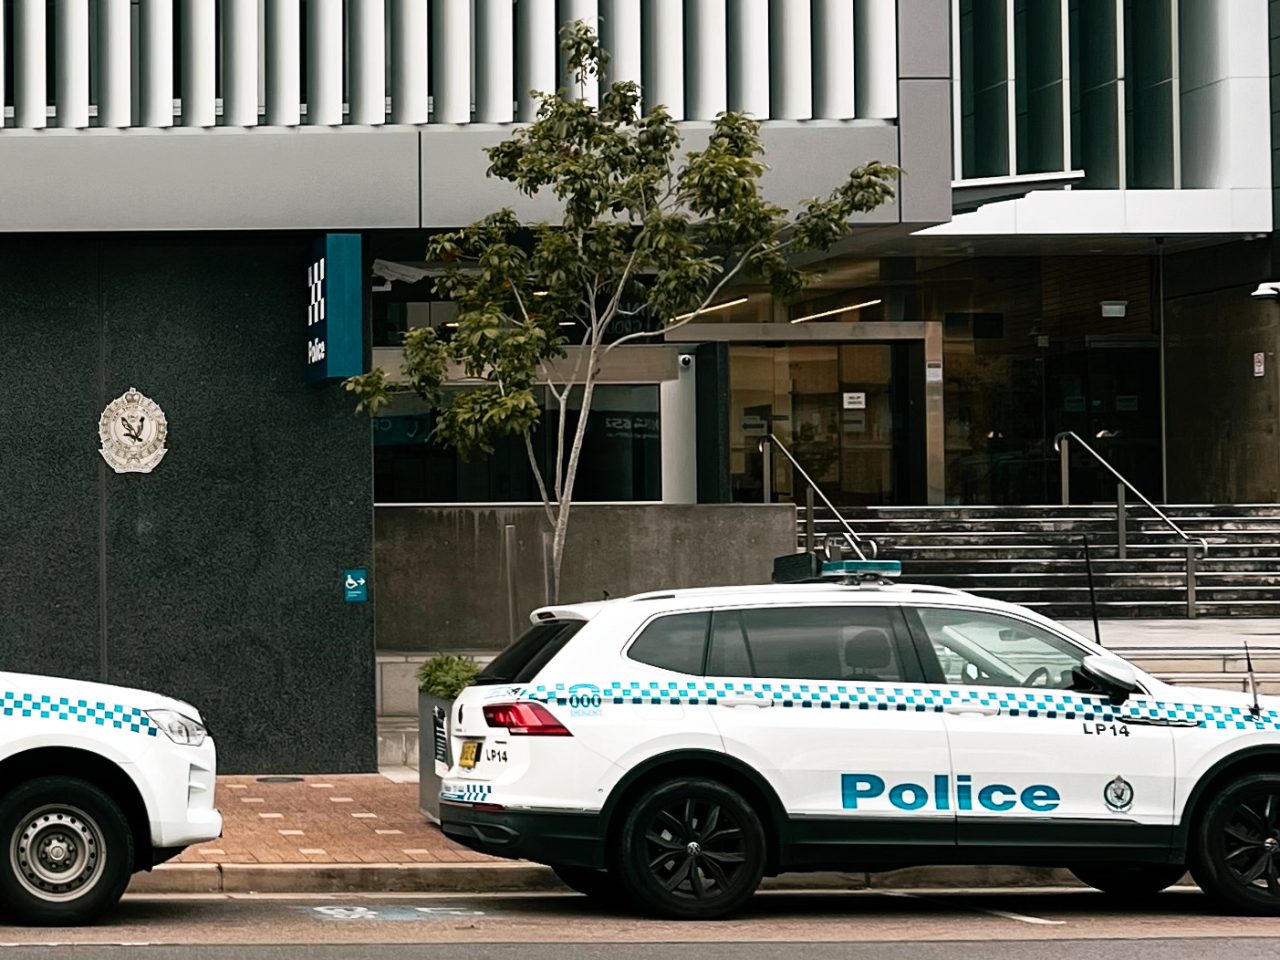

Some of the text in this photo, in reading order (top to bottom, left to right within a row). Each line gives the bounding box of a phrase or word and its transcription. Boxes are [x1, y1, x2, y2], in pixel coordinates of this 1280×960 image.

[308, 337, 326, 365] Police
[569, 693, 602, 708] 000
[1083, 723, 1131, 737] LP14
[486, 749, 508, 763] LP14
[841, 773, 1061, 811] Police
